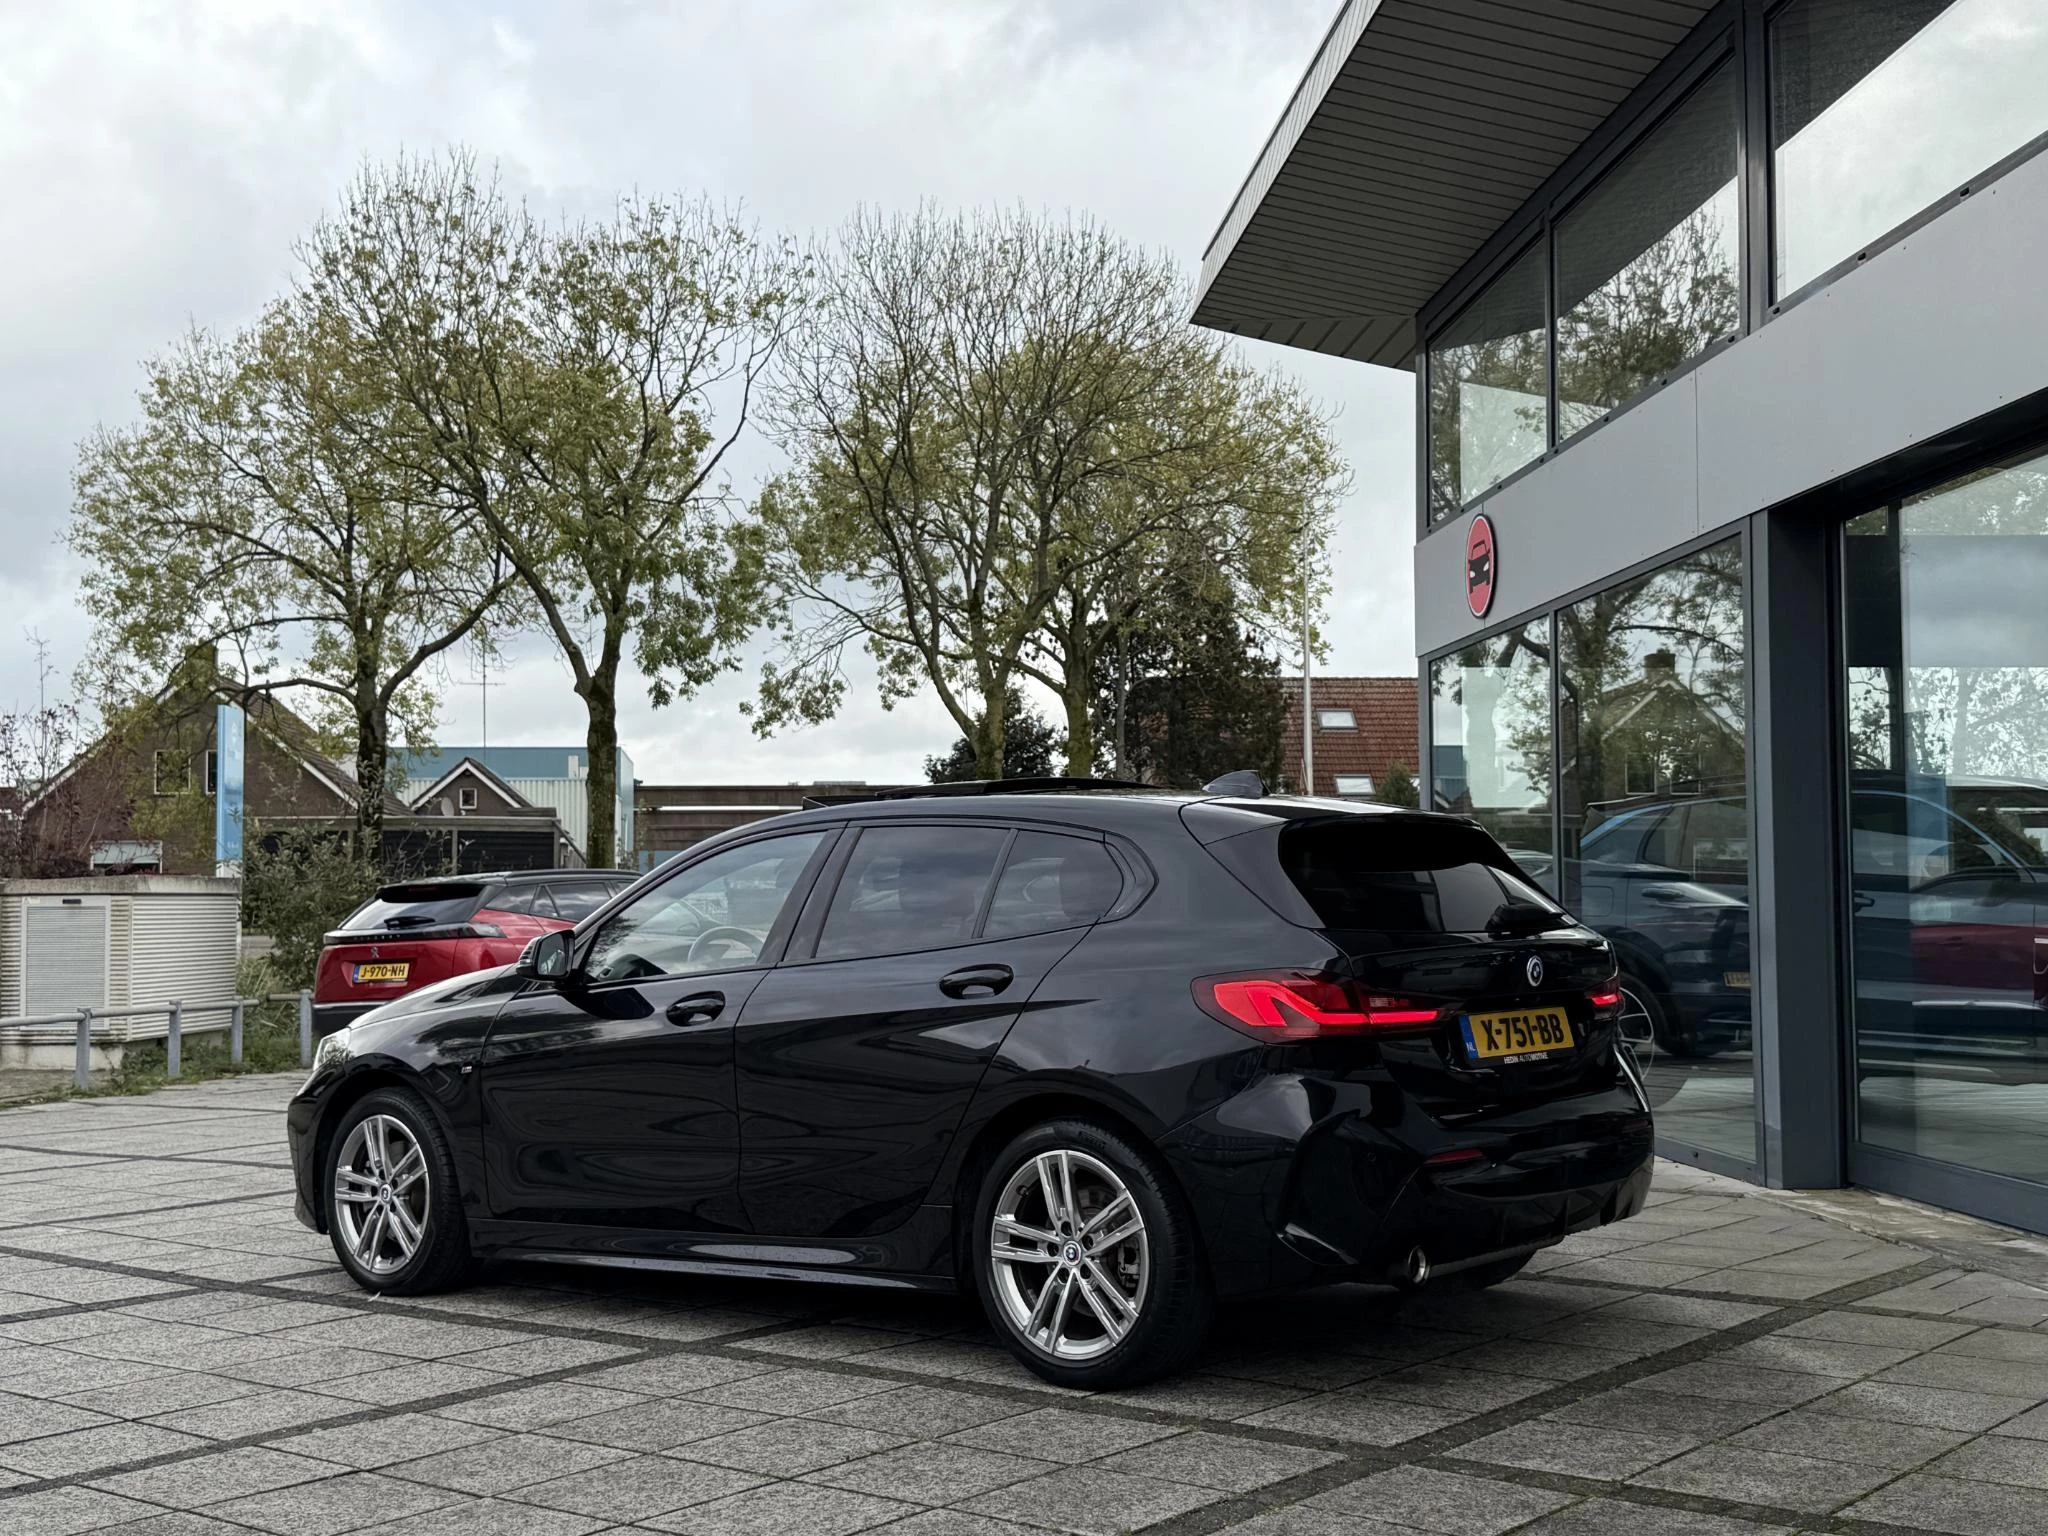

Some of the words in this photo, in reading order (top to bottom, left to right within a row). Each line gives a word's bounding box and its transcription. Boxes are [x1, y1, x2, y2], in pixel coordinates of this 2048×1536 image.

[360, 965, 406, 978] J-970-NH
[1480, 1013, 1565, 1050] X-751-BB
[1465, 1041, 1477, 1052] NL
